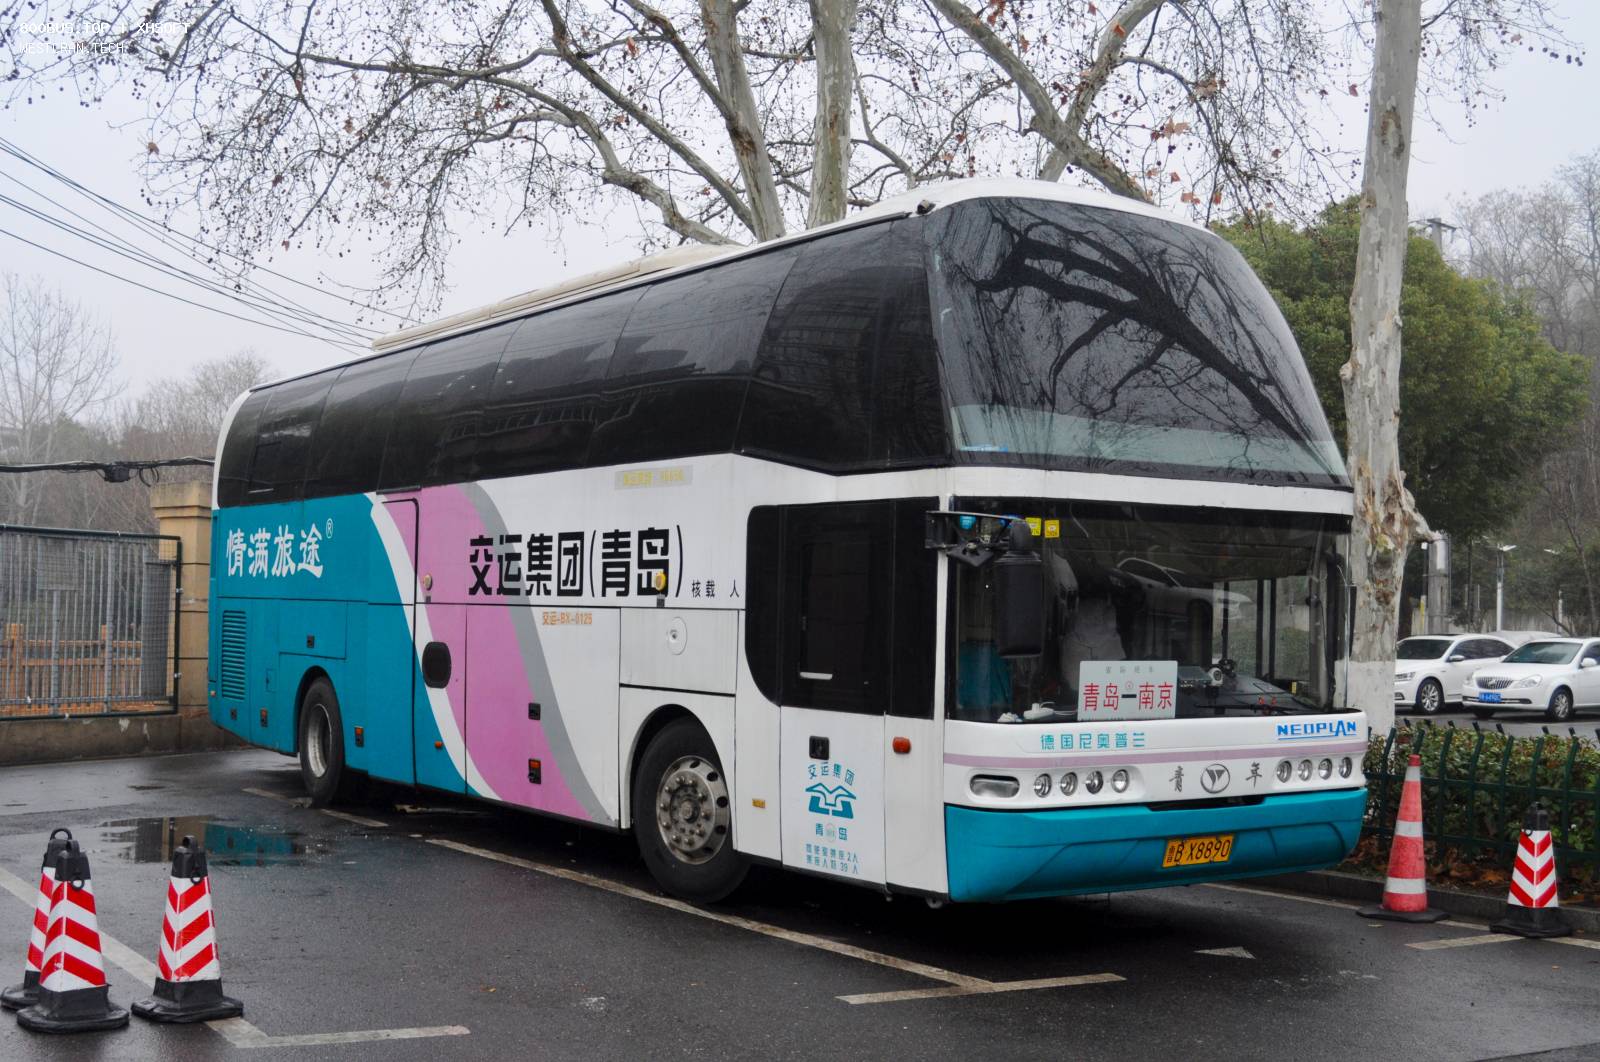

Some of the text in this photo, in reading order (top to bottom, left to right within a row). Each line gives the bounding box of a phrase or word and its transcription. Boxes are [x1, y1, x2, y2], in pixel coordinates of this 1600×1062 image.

[226, 523, 323, 578] 情满旅途
[1277, 720, 1357, 737] NEOPLAN
[1040, 732, 1145, 750] 德国尼奥普兰
[808, 762, 855, 786] 交运集团
